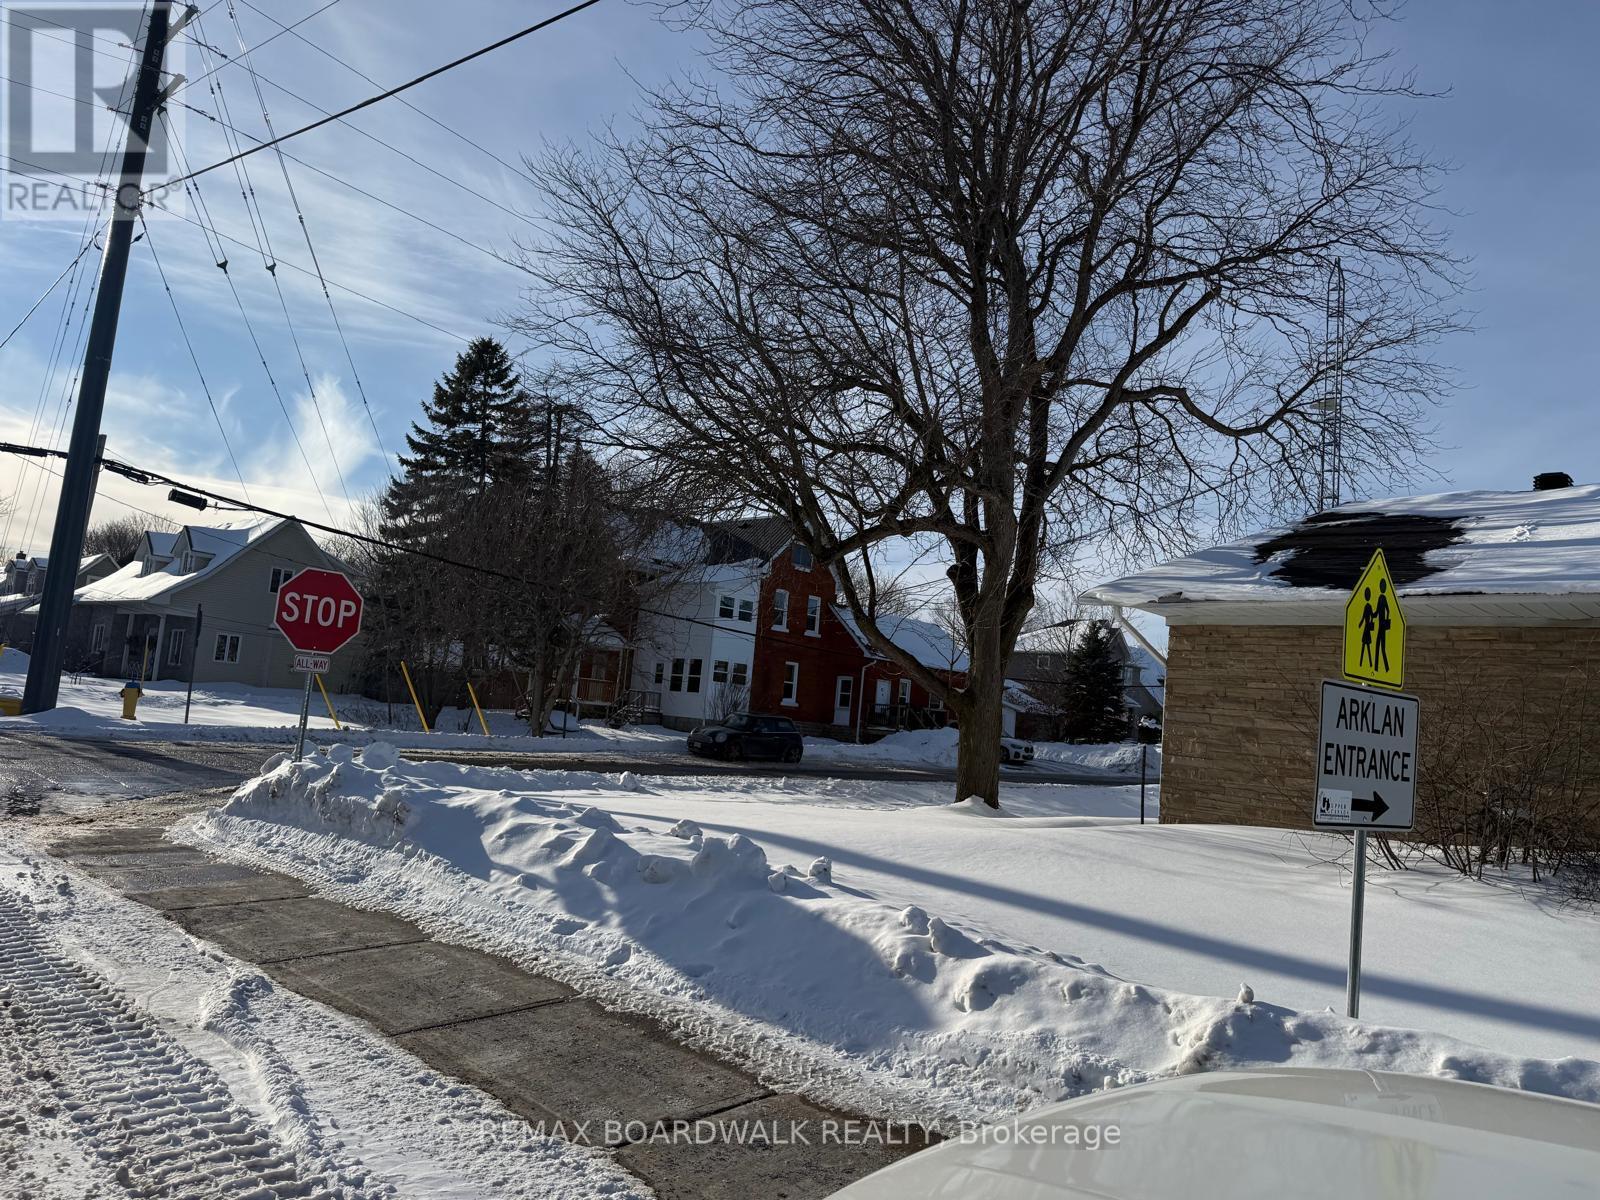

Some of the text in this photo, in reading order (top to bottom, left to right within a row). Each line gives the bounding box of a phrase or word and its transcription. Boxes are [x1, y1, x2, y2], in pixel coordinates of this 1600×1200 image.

[282, 592, 357, 628] STOP
[296, 659, 328, 670] ALL-WAY
[1336, 697, 1405, 738] ARKLAN
[1324, 742, 1411, 782] ENTRANCE
